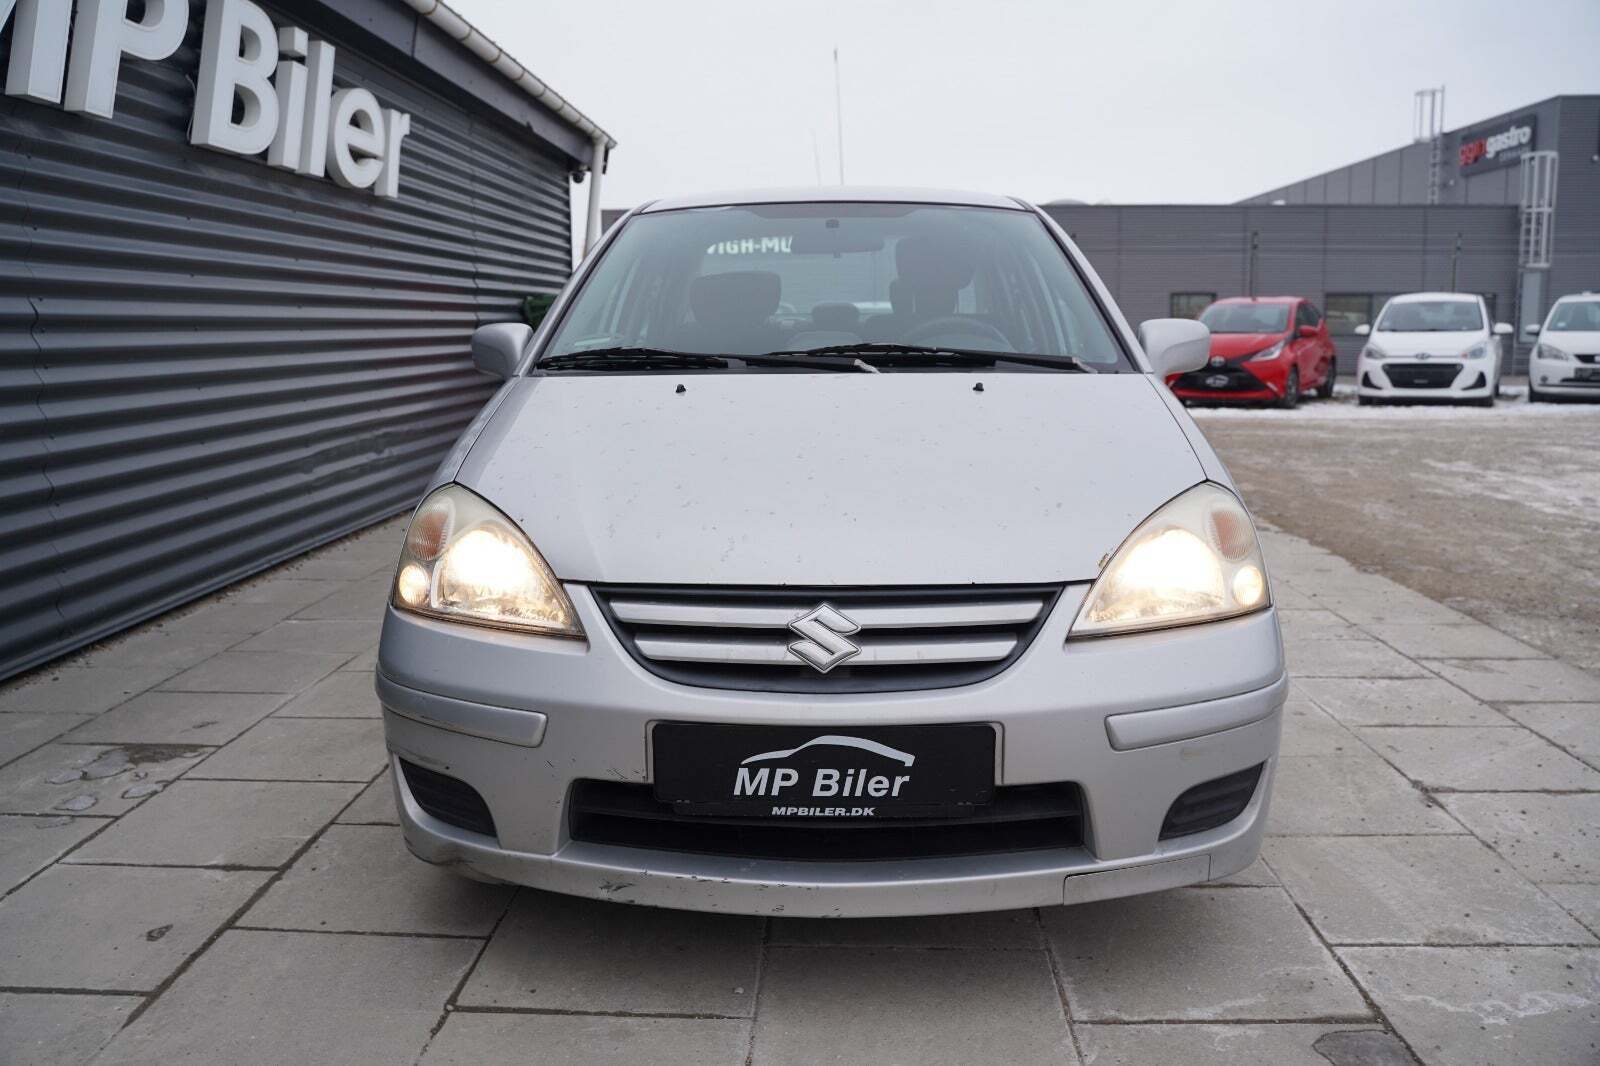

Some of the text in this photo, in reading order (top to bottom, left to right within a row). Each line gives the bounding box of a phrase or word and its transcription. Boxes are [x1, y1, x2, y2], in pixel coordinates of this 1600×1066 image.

[190, 0, 411, 199] Biler
[733, 767, 910, 797] MP Biler
[771, 806, 876, 817] MPBILER.DK
